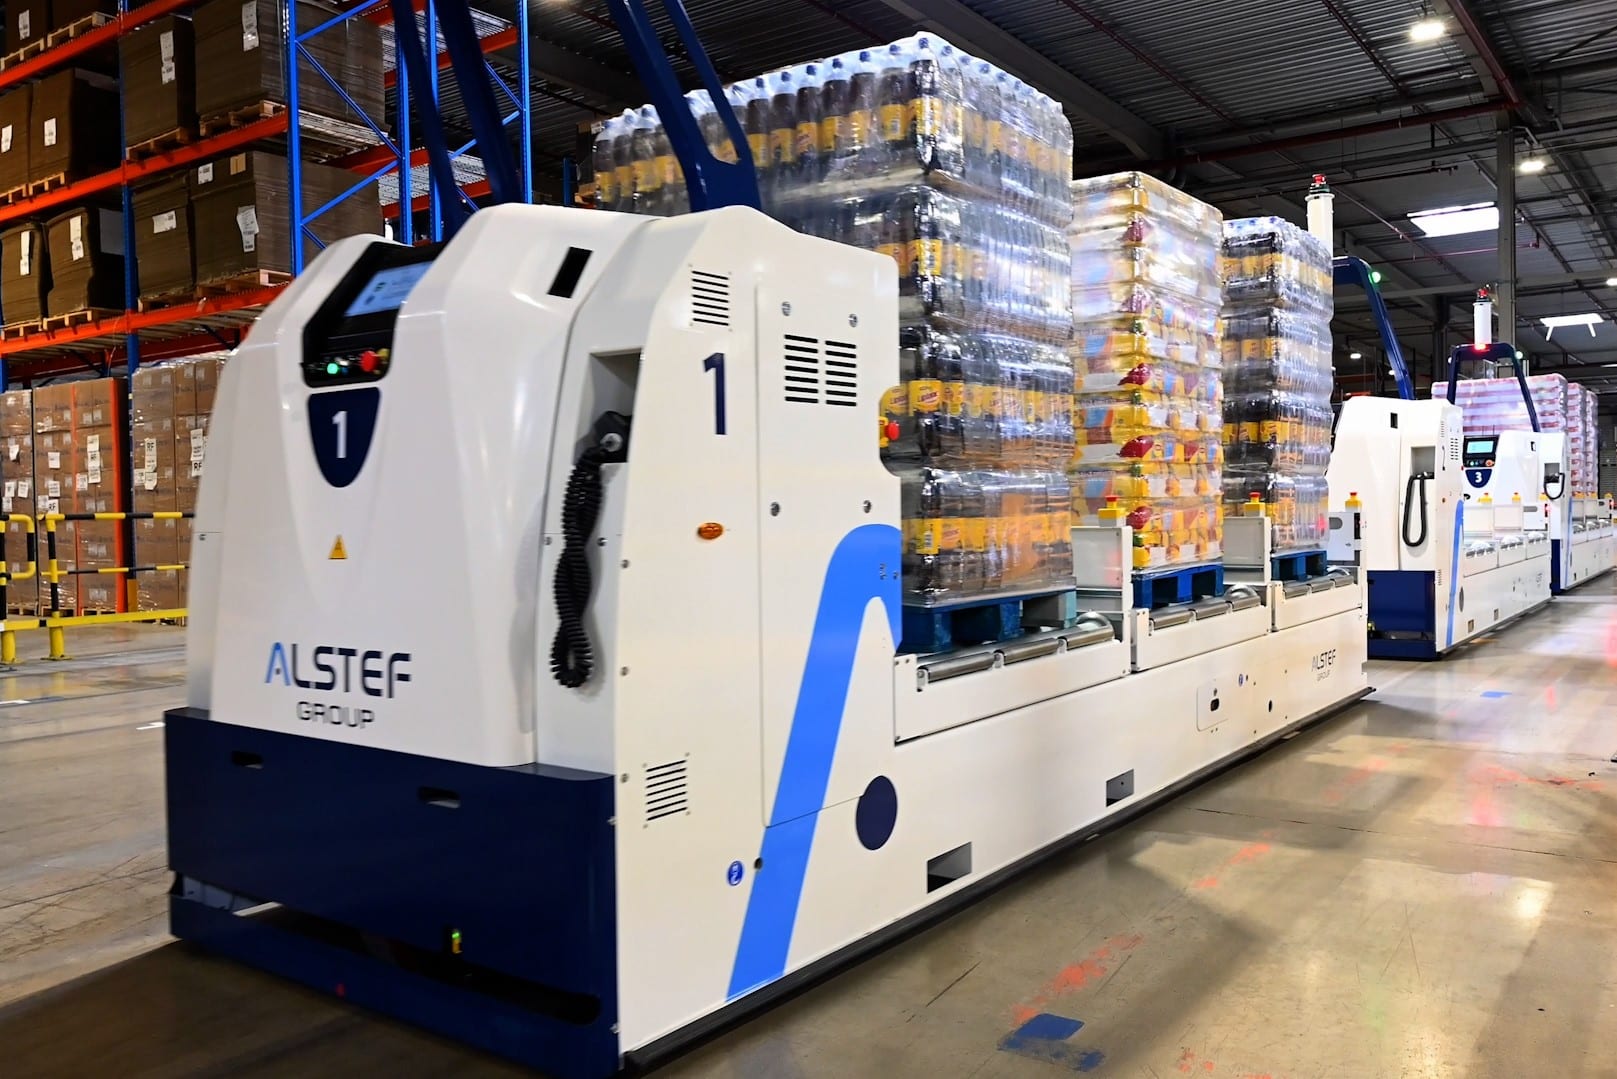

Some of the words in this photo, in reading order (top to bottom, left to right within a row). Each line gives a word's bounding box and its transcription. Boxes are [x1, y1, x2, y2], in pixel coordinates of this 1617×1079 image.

[702, 352, 726, 435] 1
[332, 410, 348, 459] 1
[1474, 471, 1483, 483] 3
[264, 641, 412, 699] ALSTEF
[1311, 648, 1336, 672] ALSTEF
[296, 700, 375, 729] GROUP
